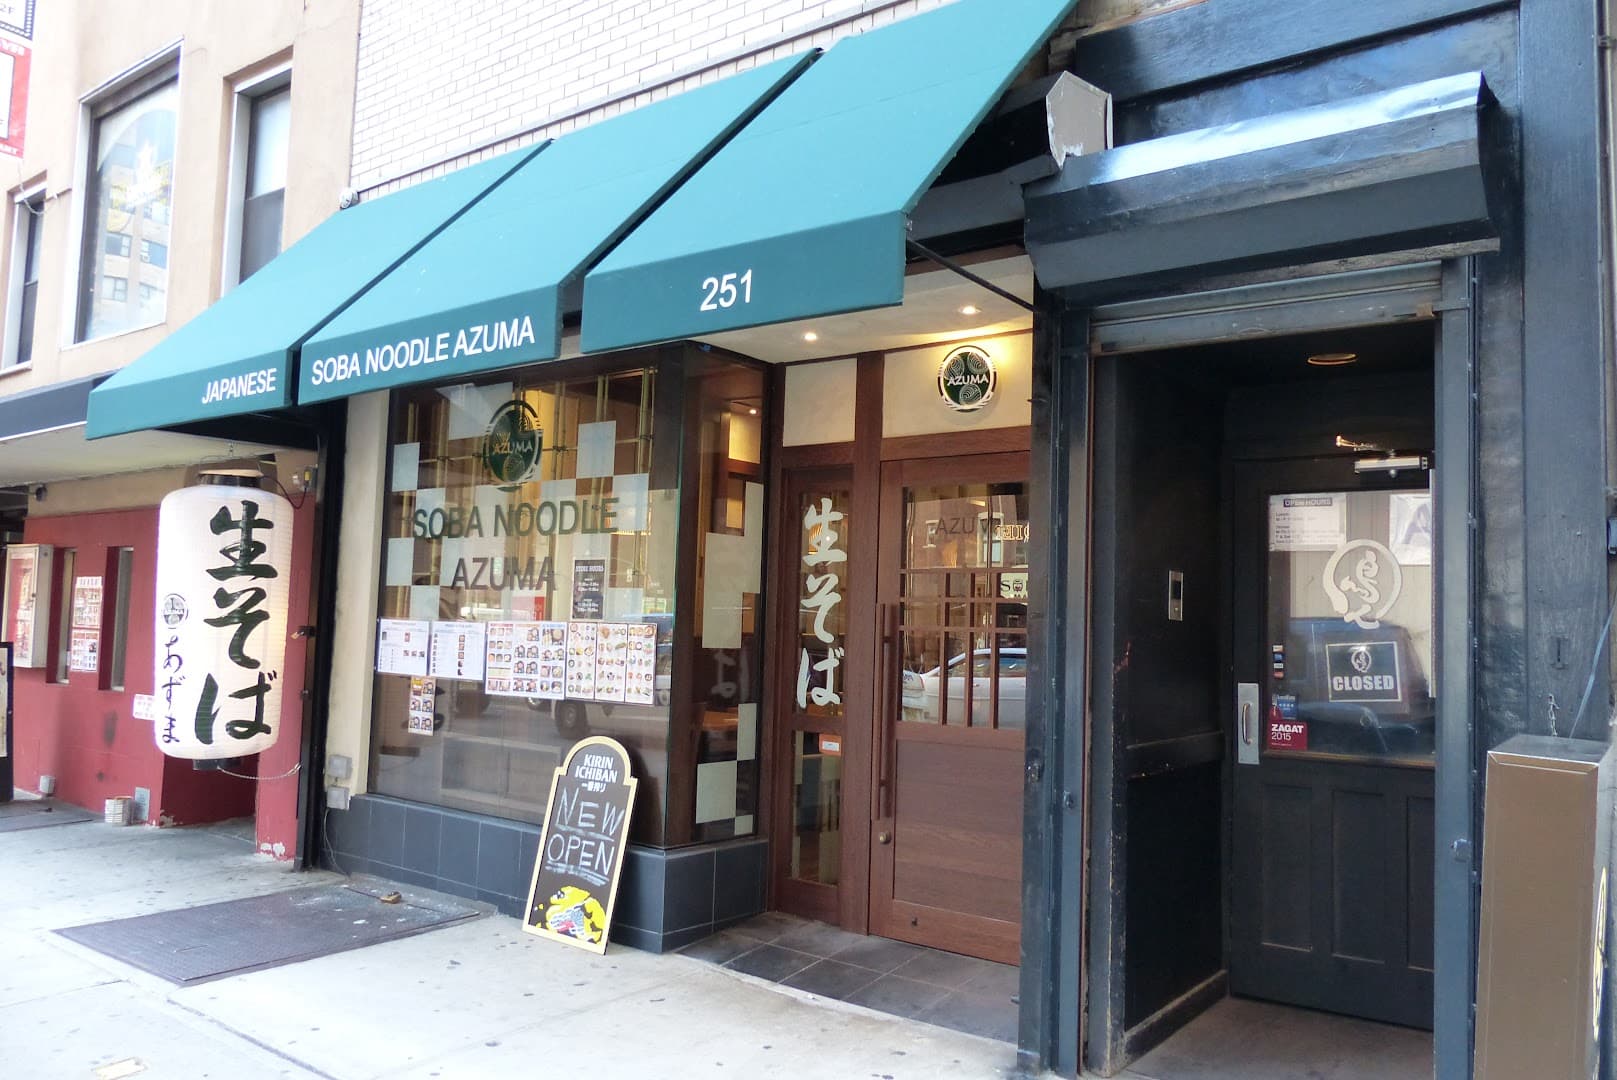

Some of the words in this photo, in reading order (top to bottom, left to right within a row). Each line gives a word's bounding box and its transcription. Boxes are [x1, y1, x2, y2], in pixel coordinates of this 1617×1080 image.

[700, 269, 753, 312] 251
[311, 358, 361, 385] SOBA
[365, 333, 450, 375] NOODLE
[453, 316, 535, 358] AZUMA
[202, 367, 277, 404] JAPANESE
[947, 373, 989, 386] AZUMA
[413, 506, 484, 539] SOBA
[494, 497, 620, 537] NOODLE
[451, 556, 557, 591] AZUMA
[797, 498, 848, 709] 生そば
[195, 500, 279, 745] 生そば
[1333, 675, 1394, 691] CLOSED
[1272, 723, 1304, 733] ZAGAT
[1272, 731, 1291, 740] 2015
[575, 765, 617, 783] ICHIBAN
[584, 754, 613, 769] KIRIN
[555, 787, 625, 835] NEW
[547, 833, 615, 875] OPEN
